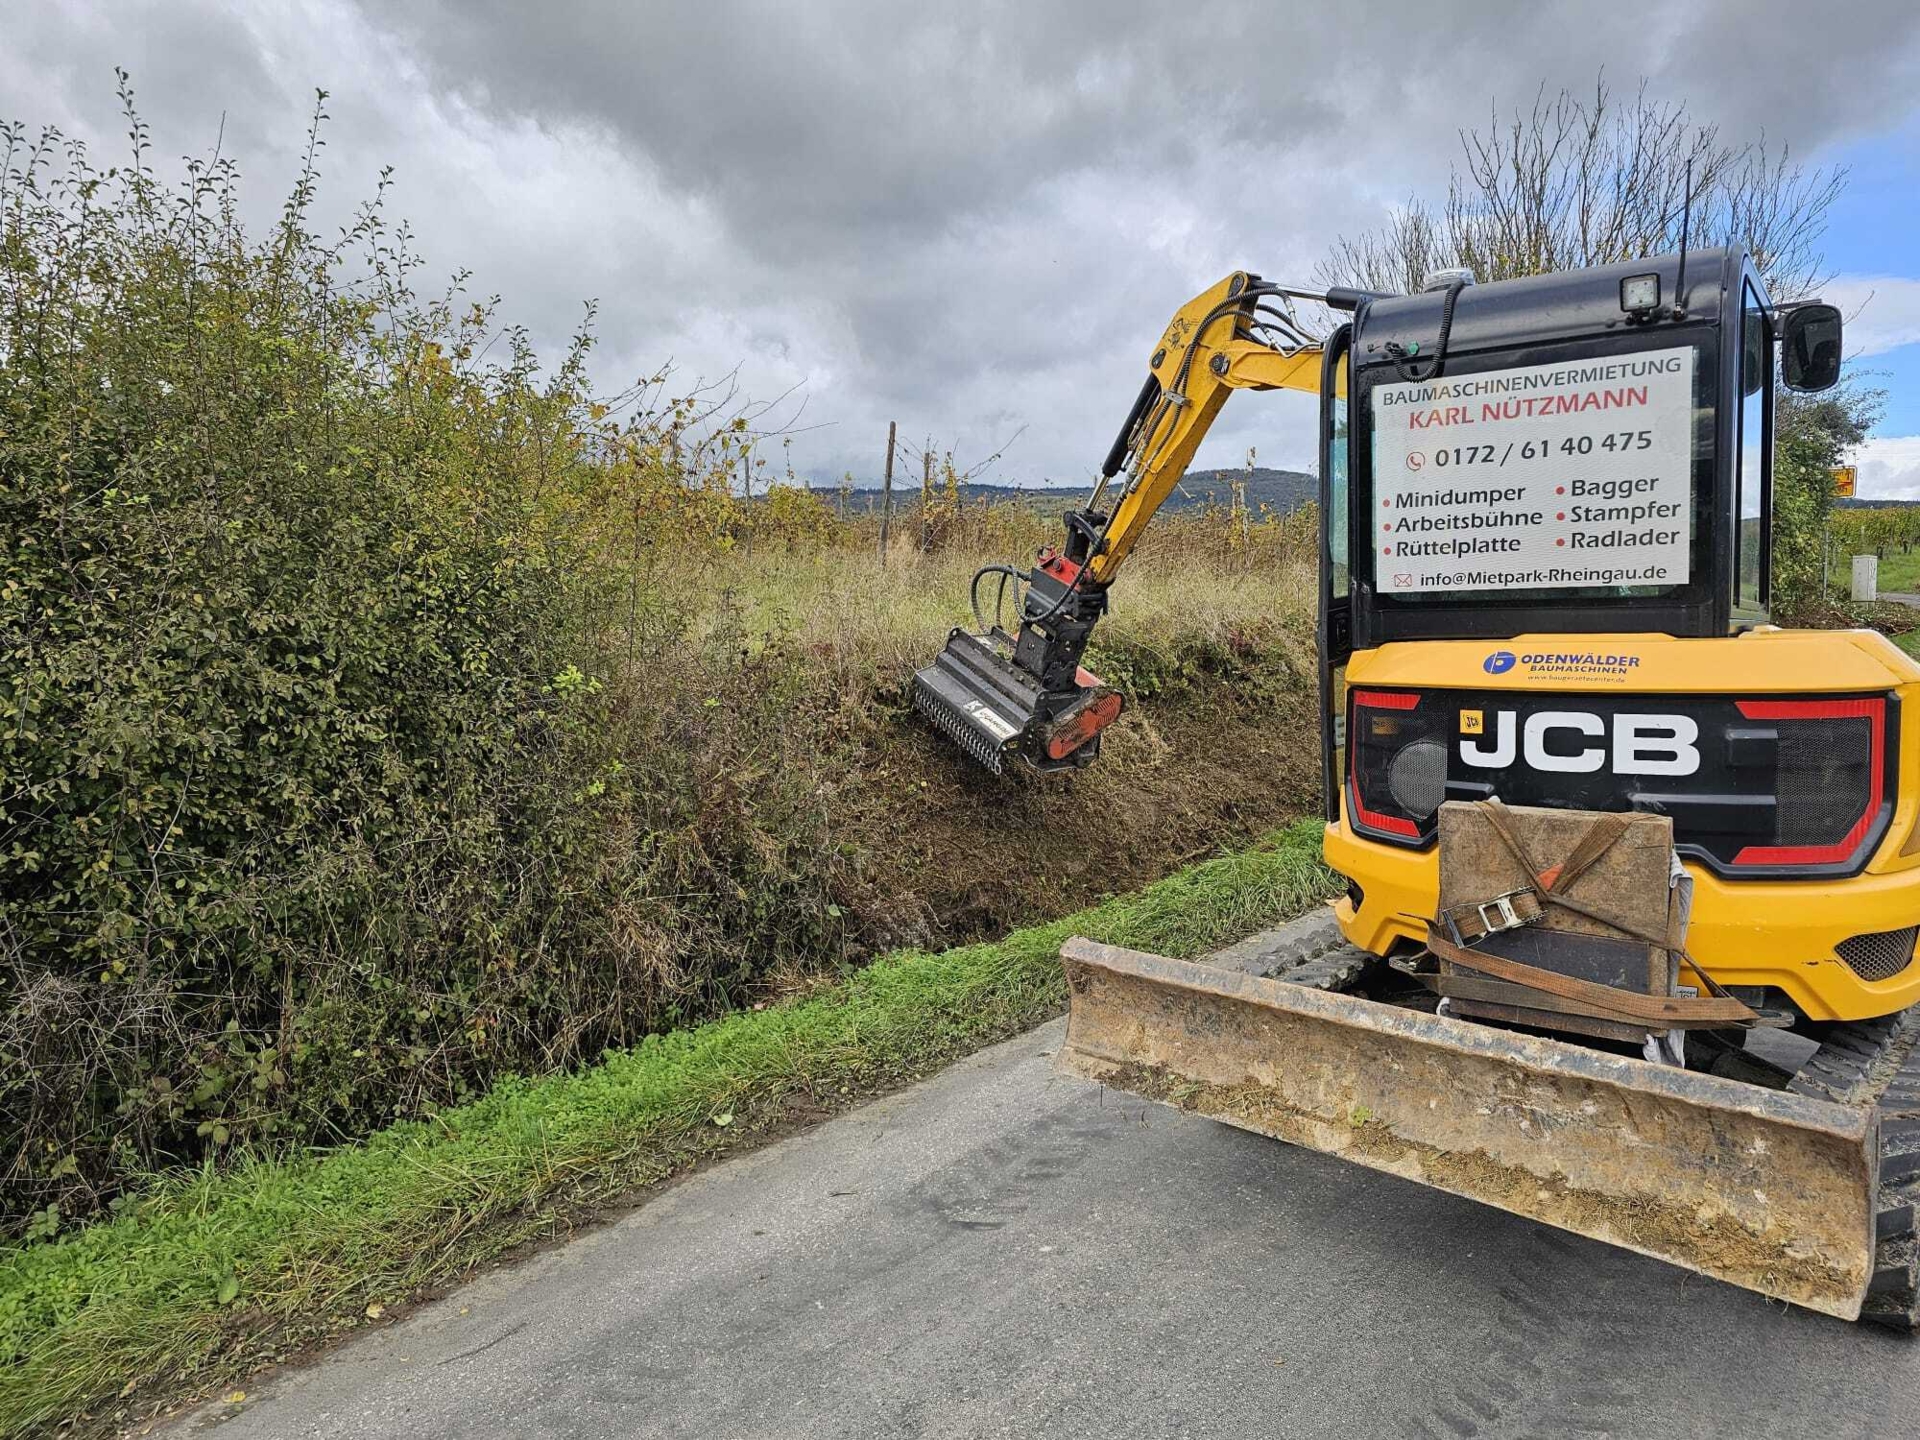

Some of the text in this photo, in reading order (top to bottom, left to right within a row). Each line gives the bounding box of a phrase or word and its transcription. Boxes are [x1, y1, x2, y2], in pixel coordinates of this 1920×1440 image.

[1383, 357, 1681, 406] BAUMASCHINENVERMIETUNG
[1409, 386, 1648, 430] KARL NÜTZMANN
[1435, 430, 1652, 467] 0172 / 61 40 475
[1395, 487, 1526, 508] Minidumper
[1571, 478, 1659, 500] Bagger
[1395, 511, 1543, 533] Arbeitsbühne
[1570, 500, 1681, 525] Stampfer
[1396, 537, 1521, 558] Rüttelplatte
[1571, 529, 1680, 549] Radlader
[1420, 565, 1667, 586] info@Mietpark-Rheingau.de
[1521, 652, 1640, 667] ODENWÄLDER
[1530, 665, 1627, 674] BAUMASCHINEN
[1460, 710, 1700, 775] JCB
